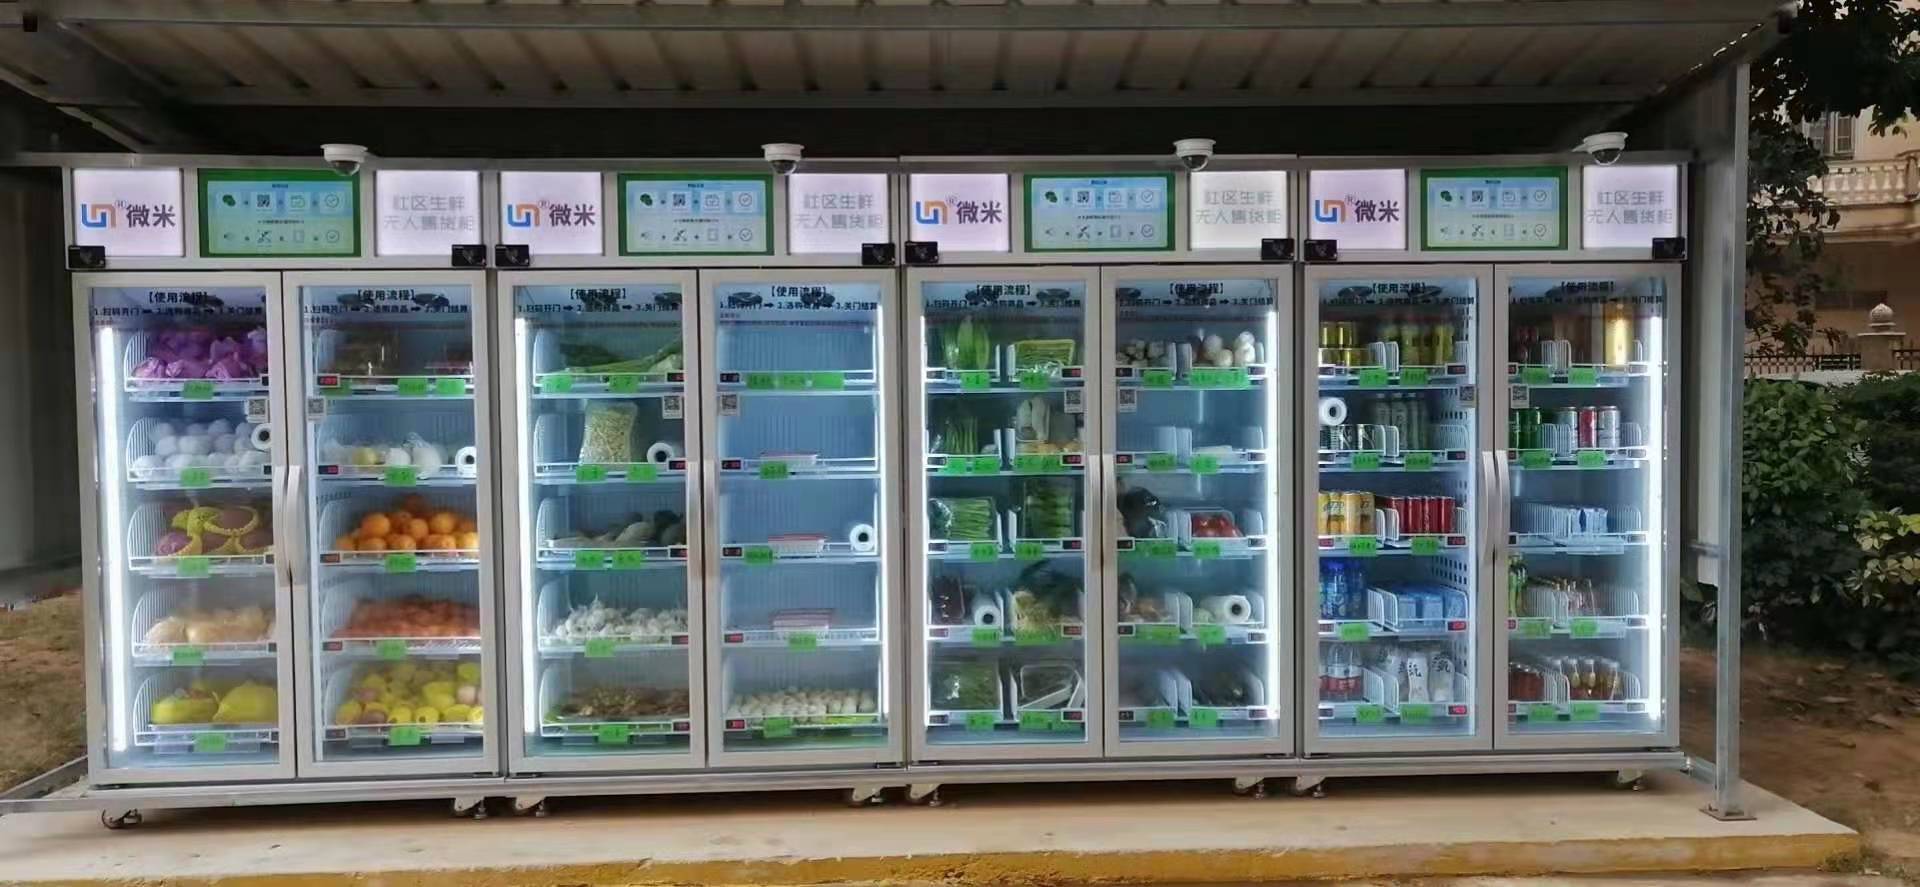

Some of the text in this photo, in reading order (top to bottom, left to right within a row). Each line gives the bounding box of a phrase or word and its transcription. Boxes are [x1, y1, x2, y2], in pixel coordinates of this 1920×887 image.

[392, 194, 465, 211] 社区生鲜
[803, 193, 873, 210] 社区生鲜
[1203, 189, 1274, 206] 社区生鲜
[1597, 190, 1665, 205] 社区生鲜
[126, 203, 176, 228] 微米
[548, 204, 596, 227] 微米
[956, 201, 1002, 225] 微米
[1354, 200, 1400, 223] 微米
